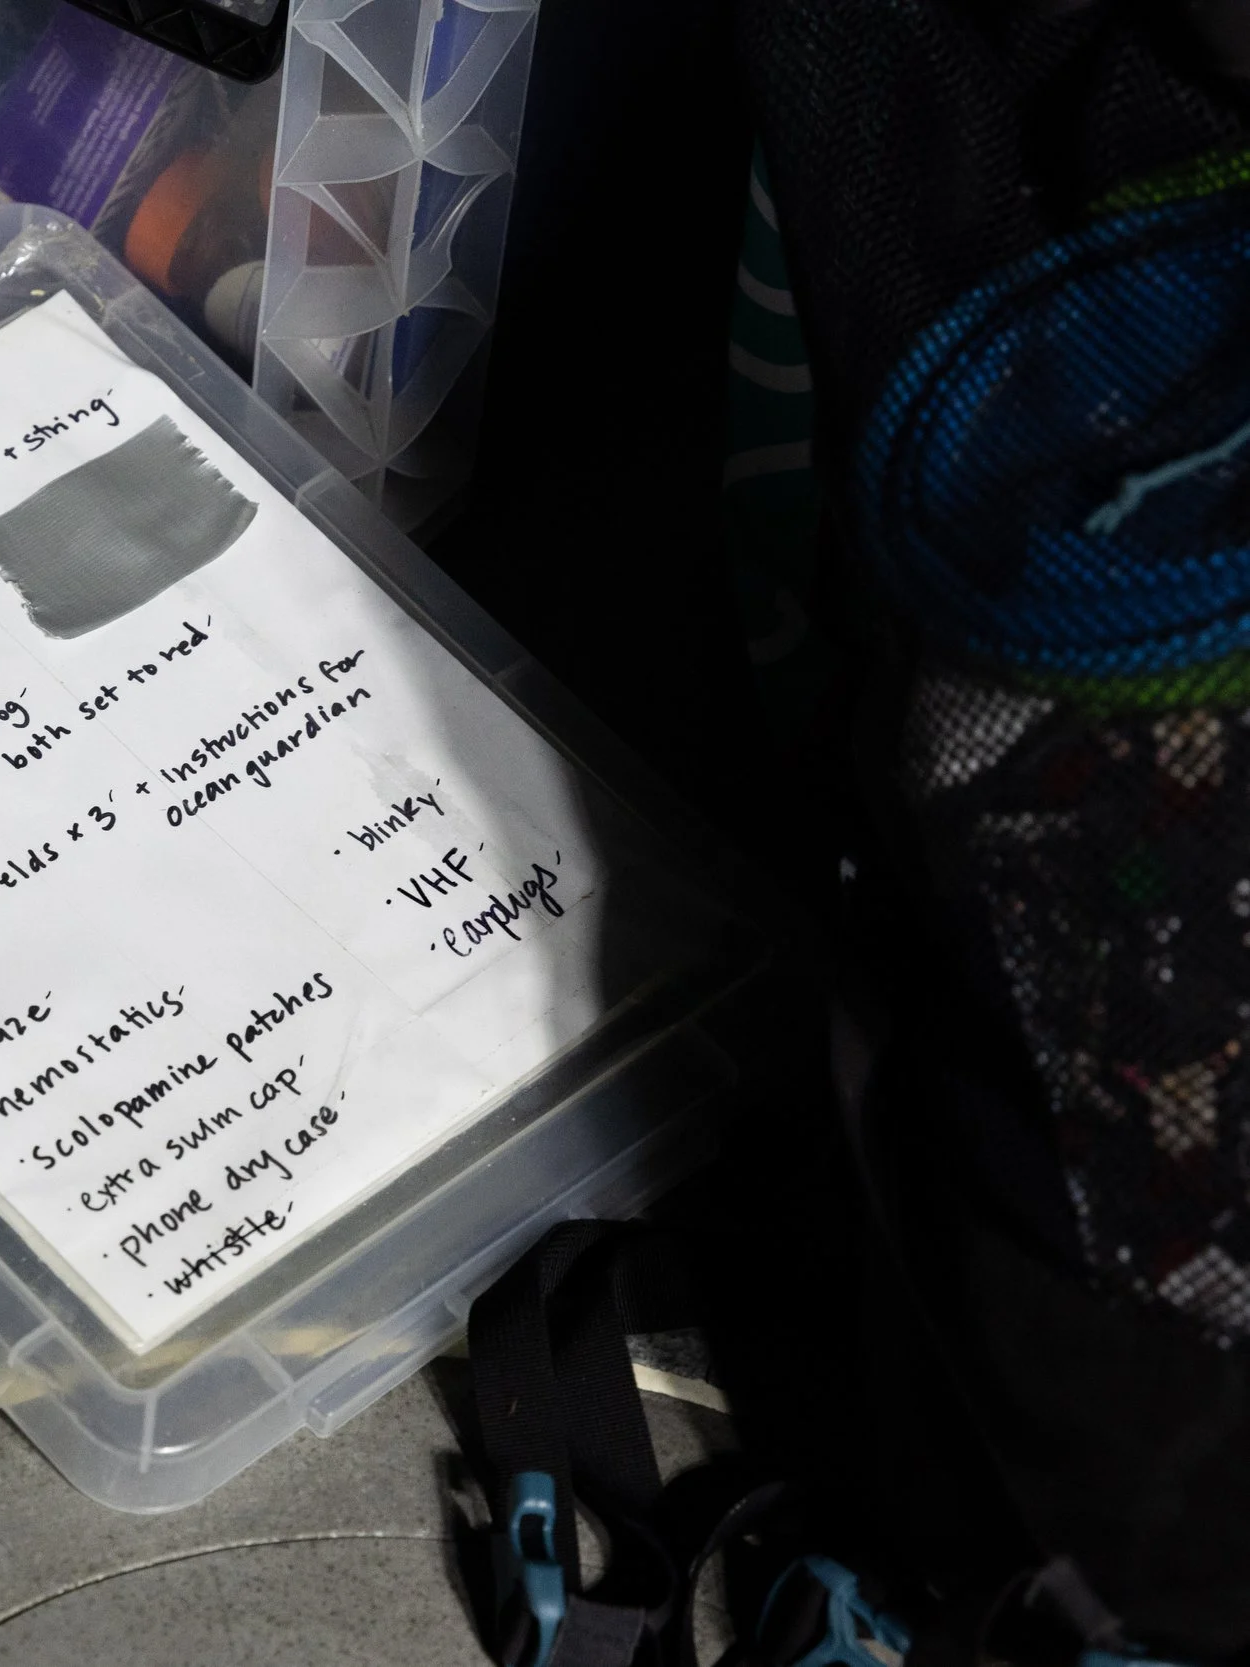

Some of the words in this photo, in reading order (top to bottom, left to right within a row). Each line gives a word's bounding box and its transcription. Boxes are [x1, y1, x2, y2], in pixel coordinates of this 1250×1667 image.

[21, 397, 121, 453] string
[0, 723, 73, 771] both
[77, 684, 120, 722] set
[125, 662, 159, 685] to
[157, 620, 210, 663] red
[317, 648, 366, 684] for
[244, 686, 373, 789] guardian
[345, 791, 446, 853] blinky
[395, 846, 475, 910] VHF
[441, 862, 567, 958] earplugs
[225, 971, 334, 1065] patches
[79, 1156, 162, 1213] extra
[164, 1106, 244, 1162] swim
[248, 1067, 303, 1111] cap
[118, 1188, 214, 1269] phone
[223, 1148, 294, 1192] dry
[283, 1104, 340, 1157] case
[162, 1208, 287, 1296] whistle
